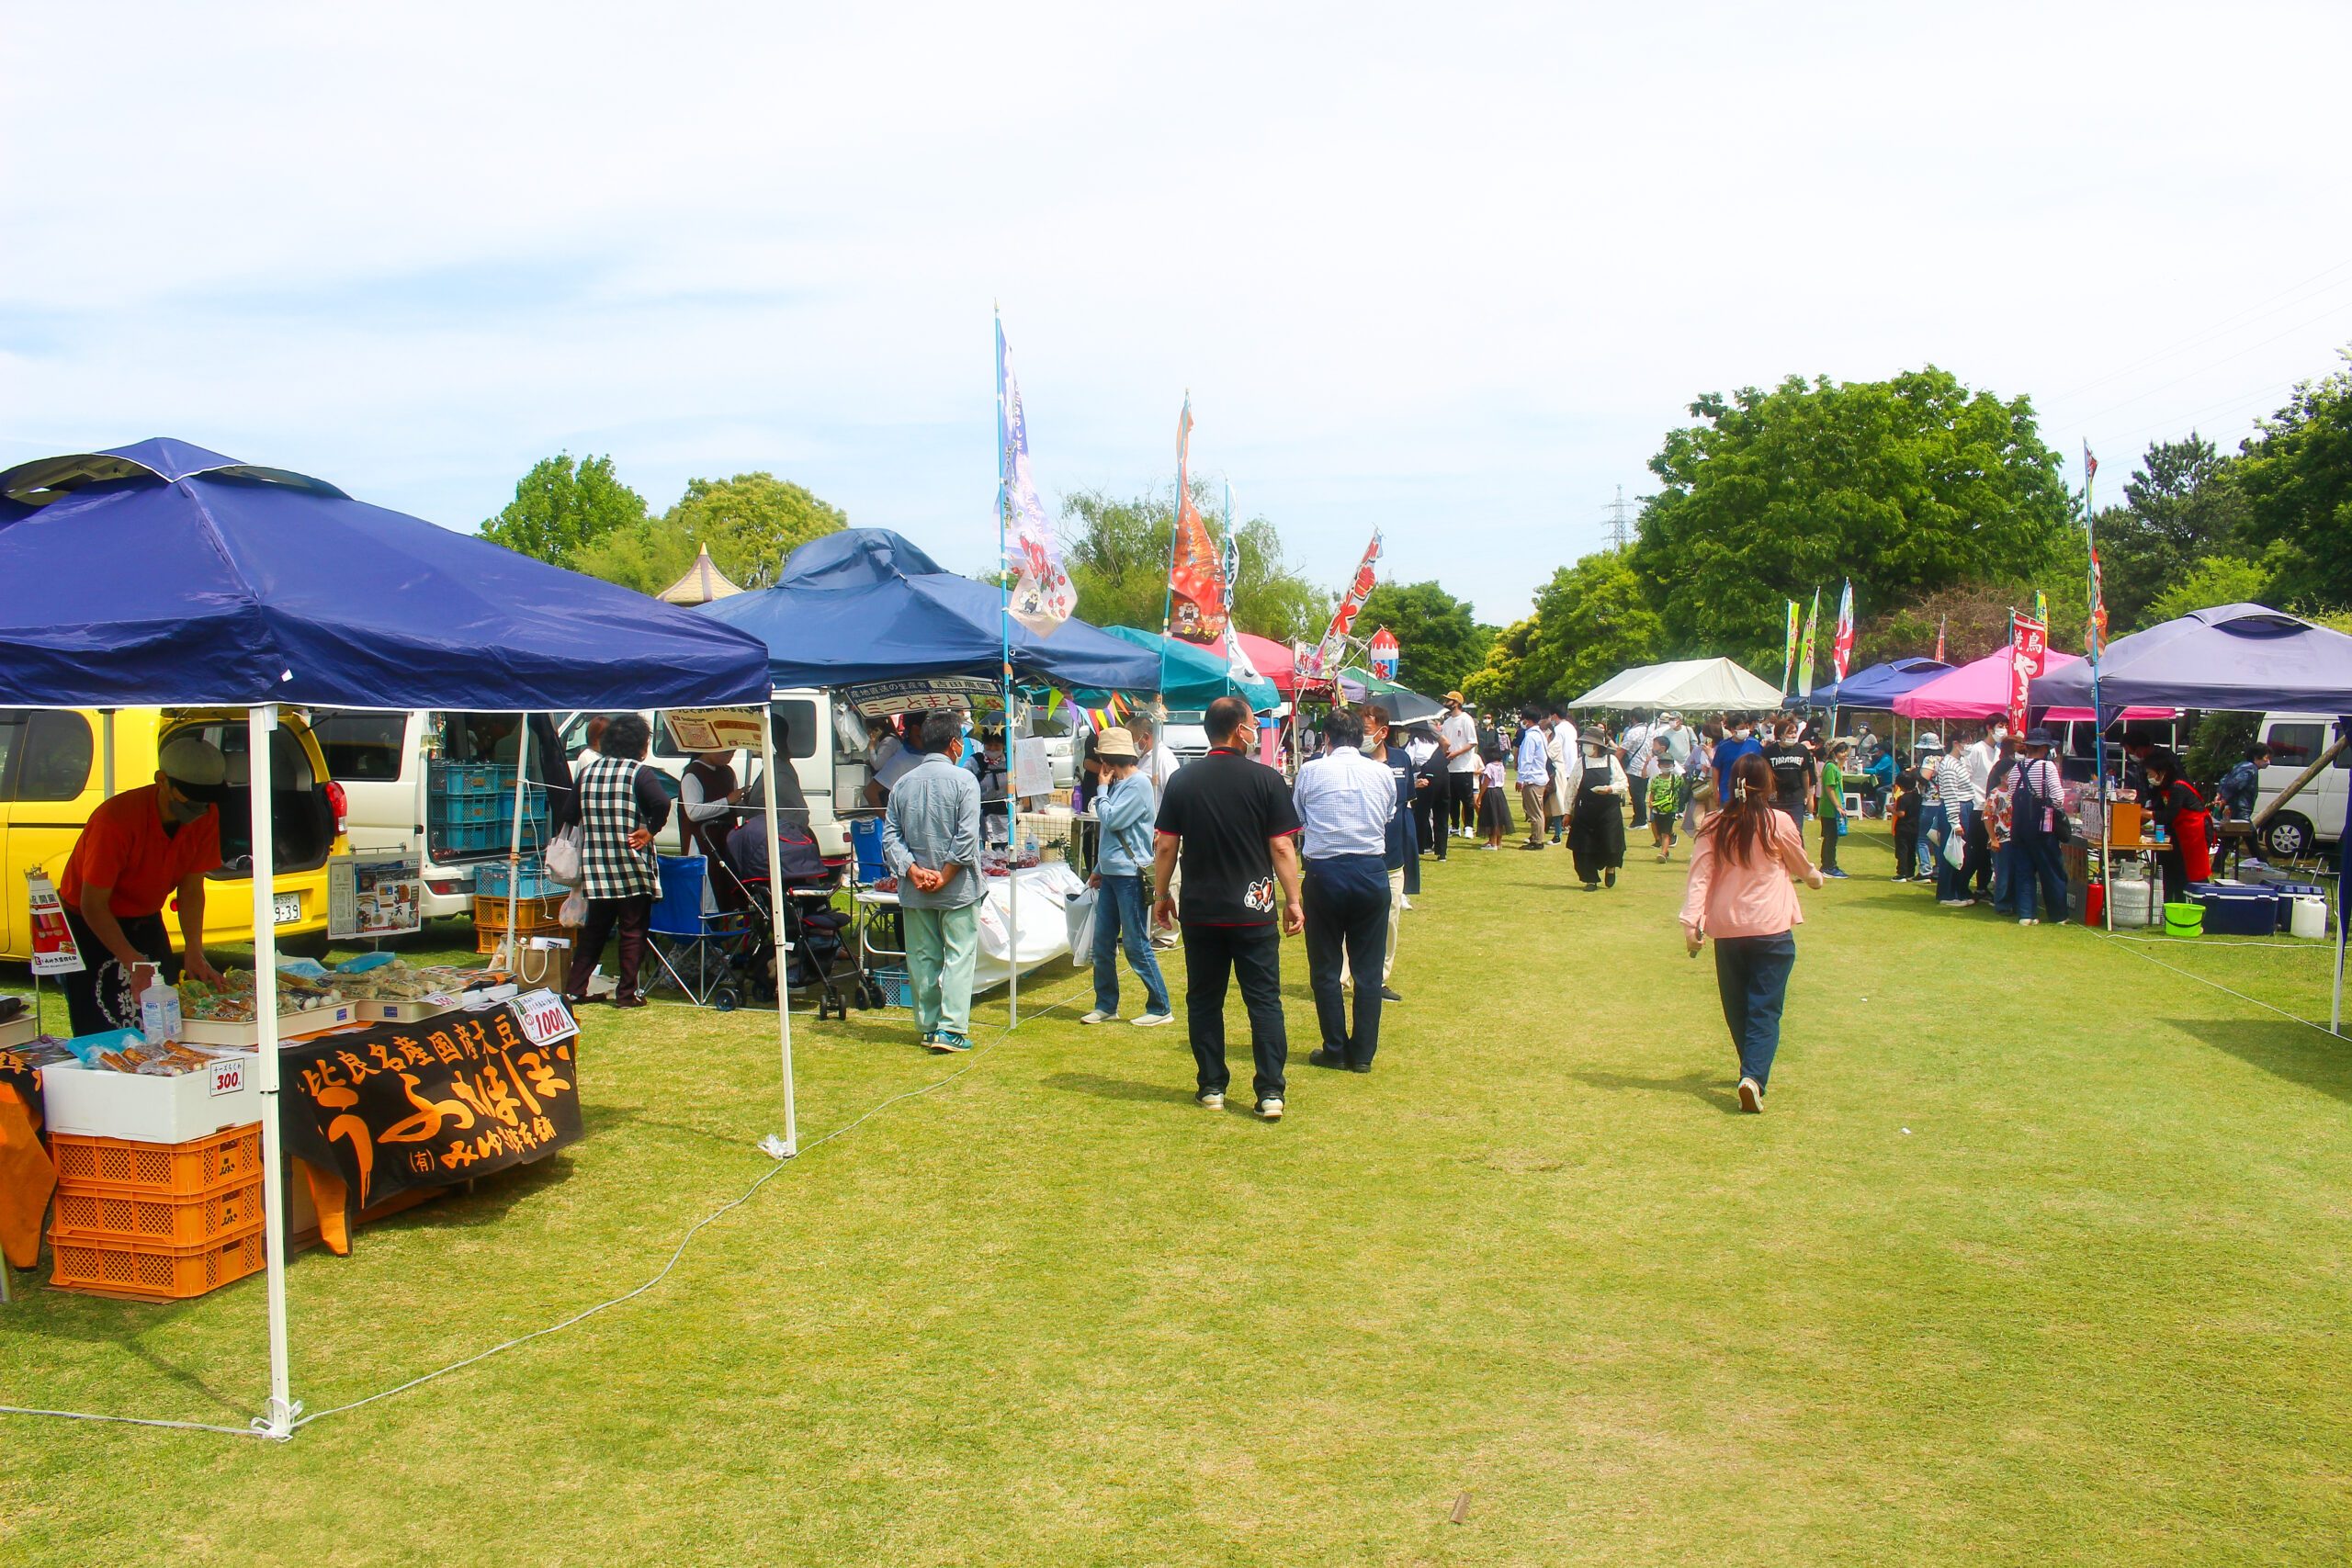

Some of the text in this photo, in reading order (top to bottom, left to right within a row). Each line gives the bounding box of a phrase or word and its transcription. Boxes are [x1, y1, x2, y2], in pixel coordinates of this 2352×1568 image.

[2014, 628, 2042, 654] 焼鳥
[1373, 661, 1391, 680] 氷
[850, 681, 927, 698] 産地直送の生産者
[934, 680, 992, 691] 吉田農園
[865, 694, 965, 715] ミニとまと
[536, 1007, 566, 1038] 1000
[217, 1072, 239, 1090] 300
